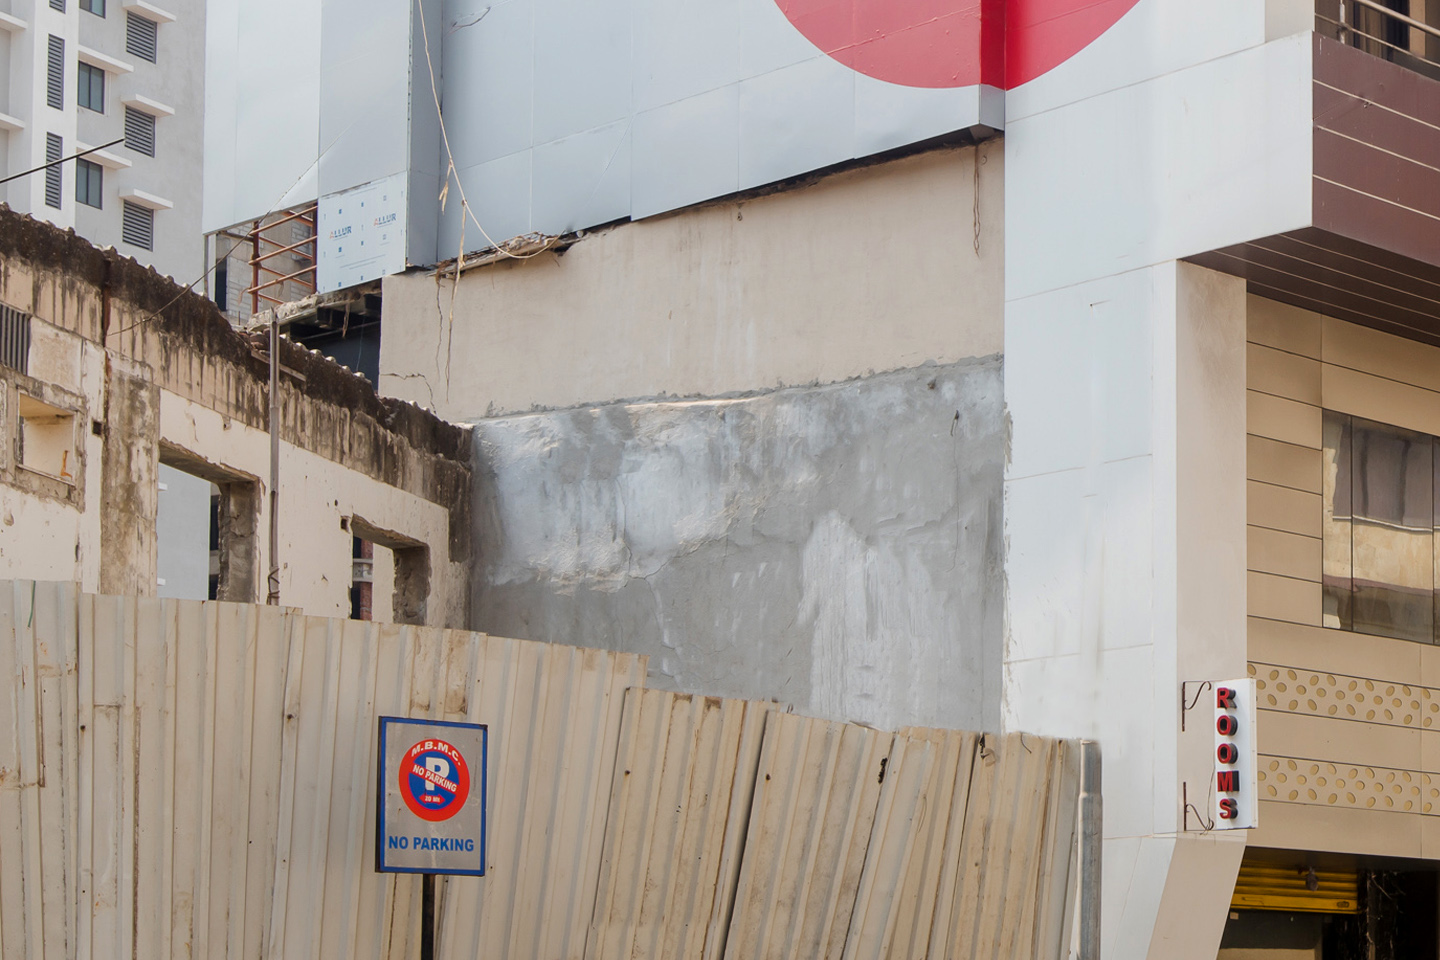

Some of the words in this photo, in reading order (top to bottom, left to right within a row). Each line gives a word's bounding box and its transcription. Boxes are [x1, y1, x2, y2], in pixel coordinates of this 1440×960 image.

[1216, 687, 1239, 820] ROOMS
[412, 764, 425, 776] NO
[425, 771, 458, 792] PARKING
[388, 836, 409, 849] NO
[413, 837, 475, 852] PARKING
